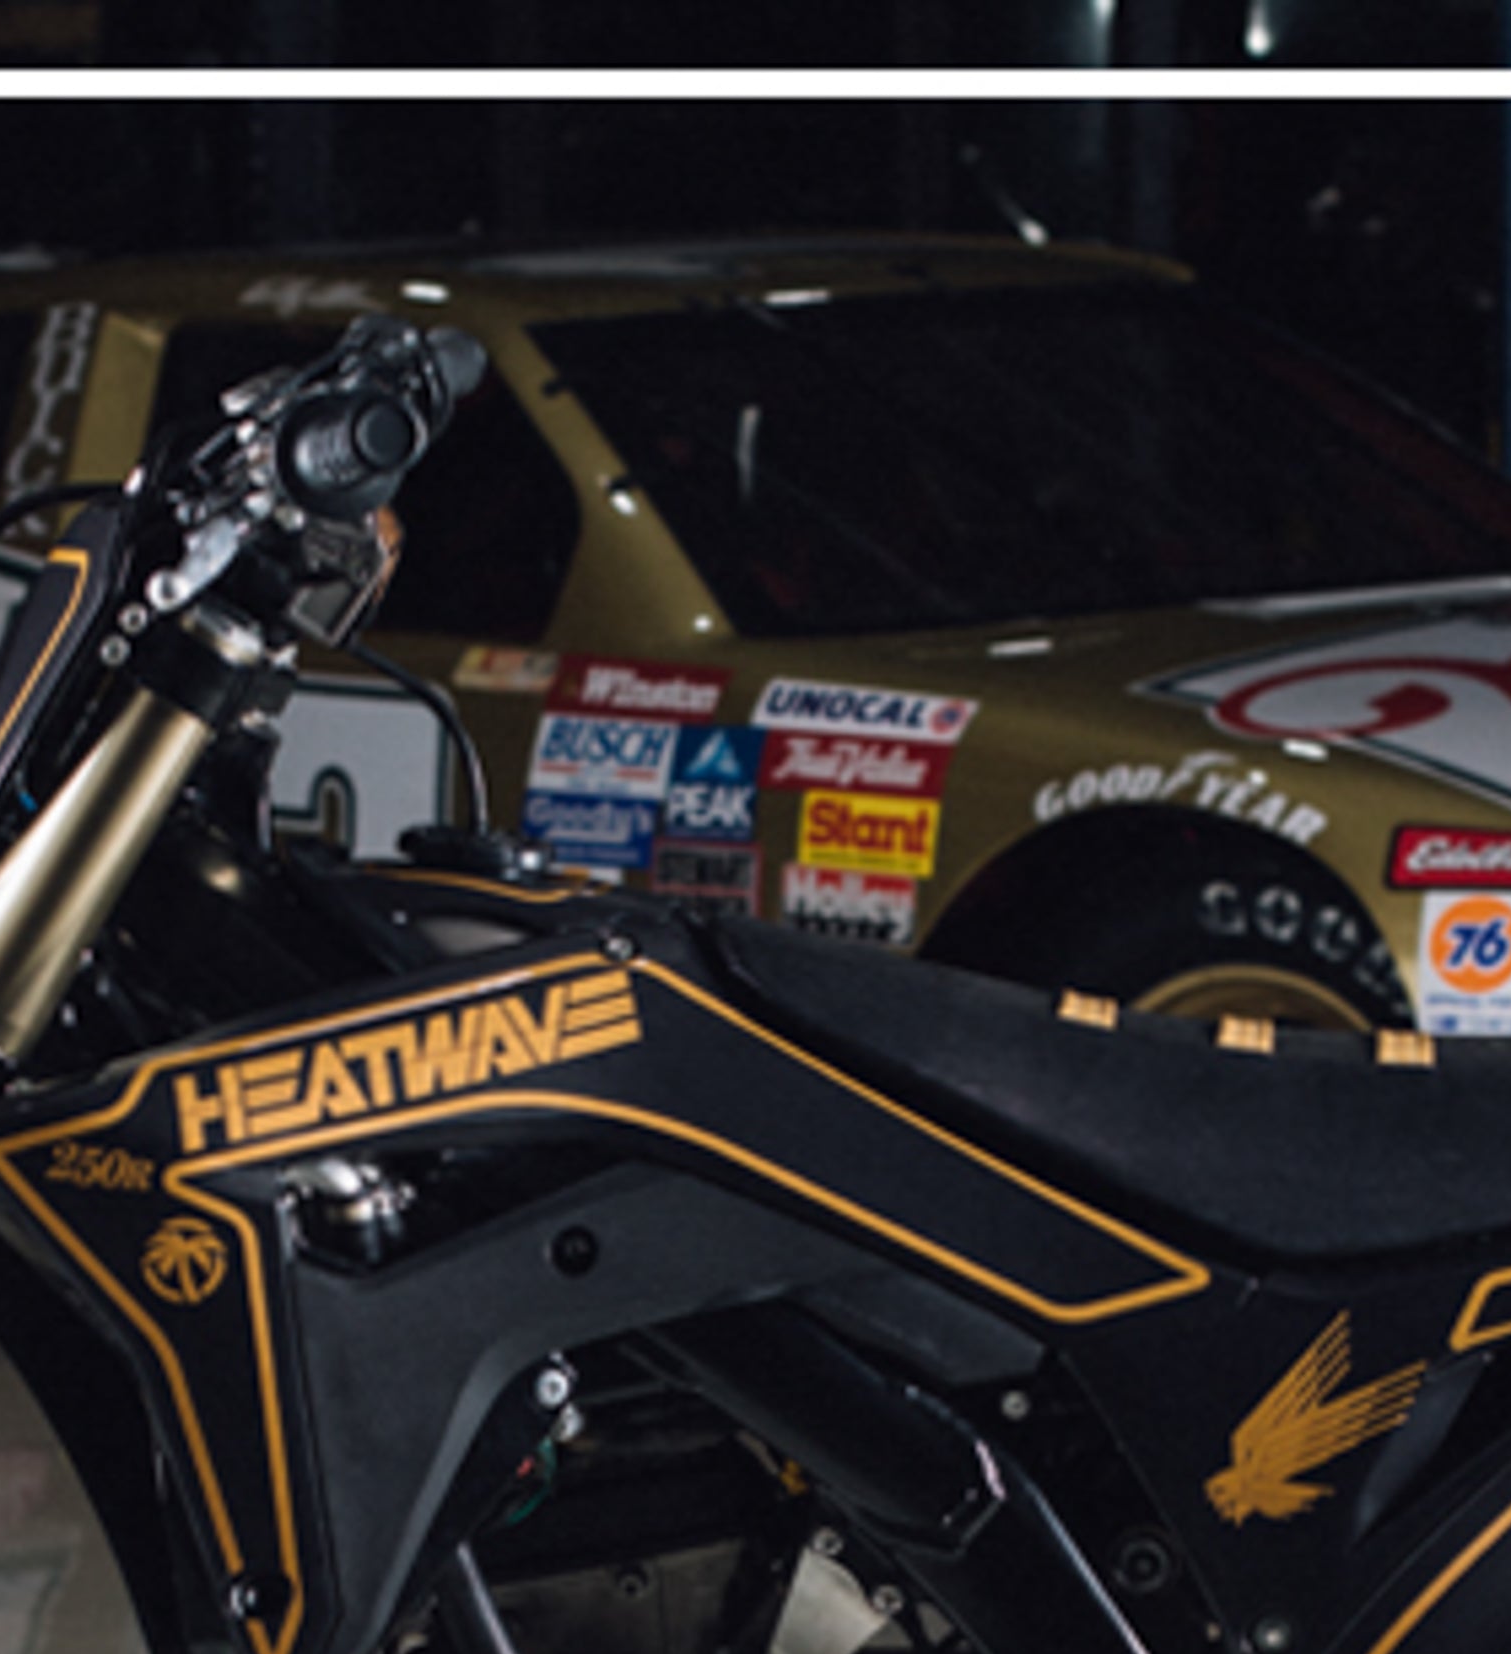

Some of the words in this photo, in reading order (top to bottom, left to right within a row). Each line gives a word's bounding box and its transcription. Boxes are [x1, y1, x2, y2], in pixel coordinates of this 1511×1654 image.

[765, 684, 926, 729] UNOCAL
[542, 714, 673, 768] BUSCH
[664, 780, 754, 830] PEAK
[806, 797, 932, 857] Stant
[1445, 916, 1511, 970] 76
[171, 966, 644, 1153] HEATWAVE
